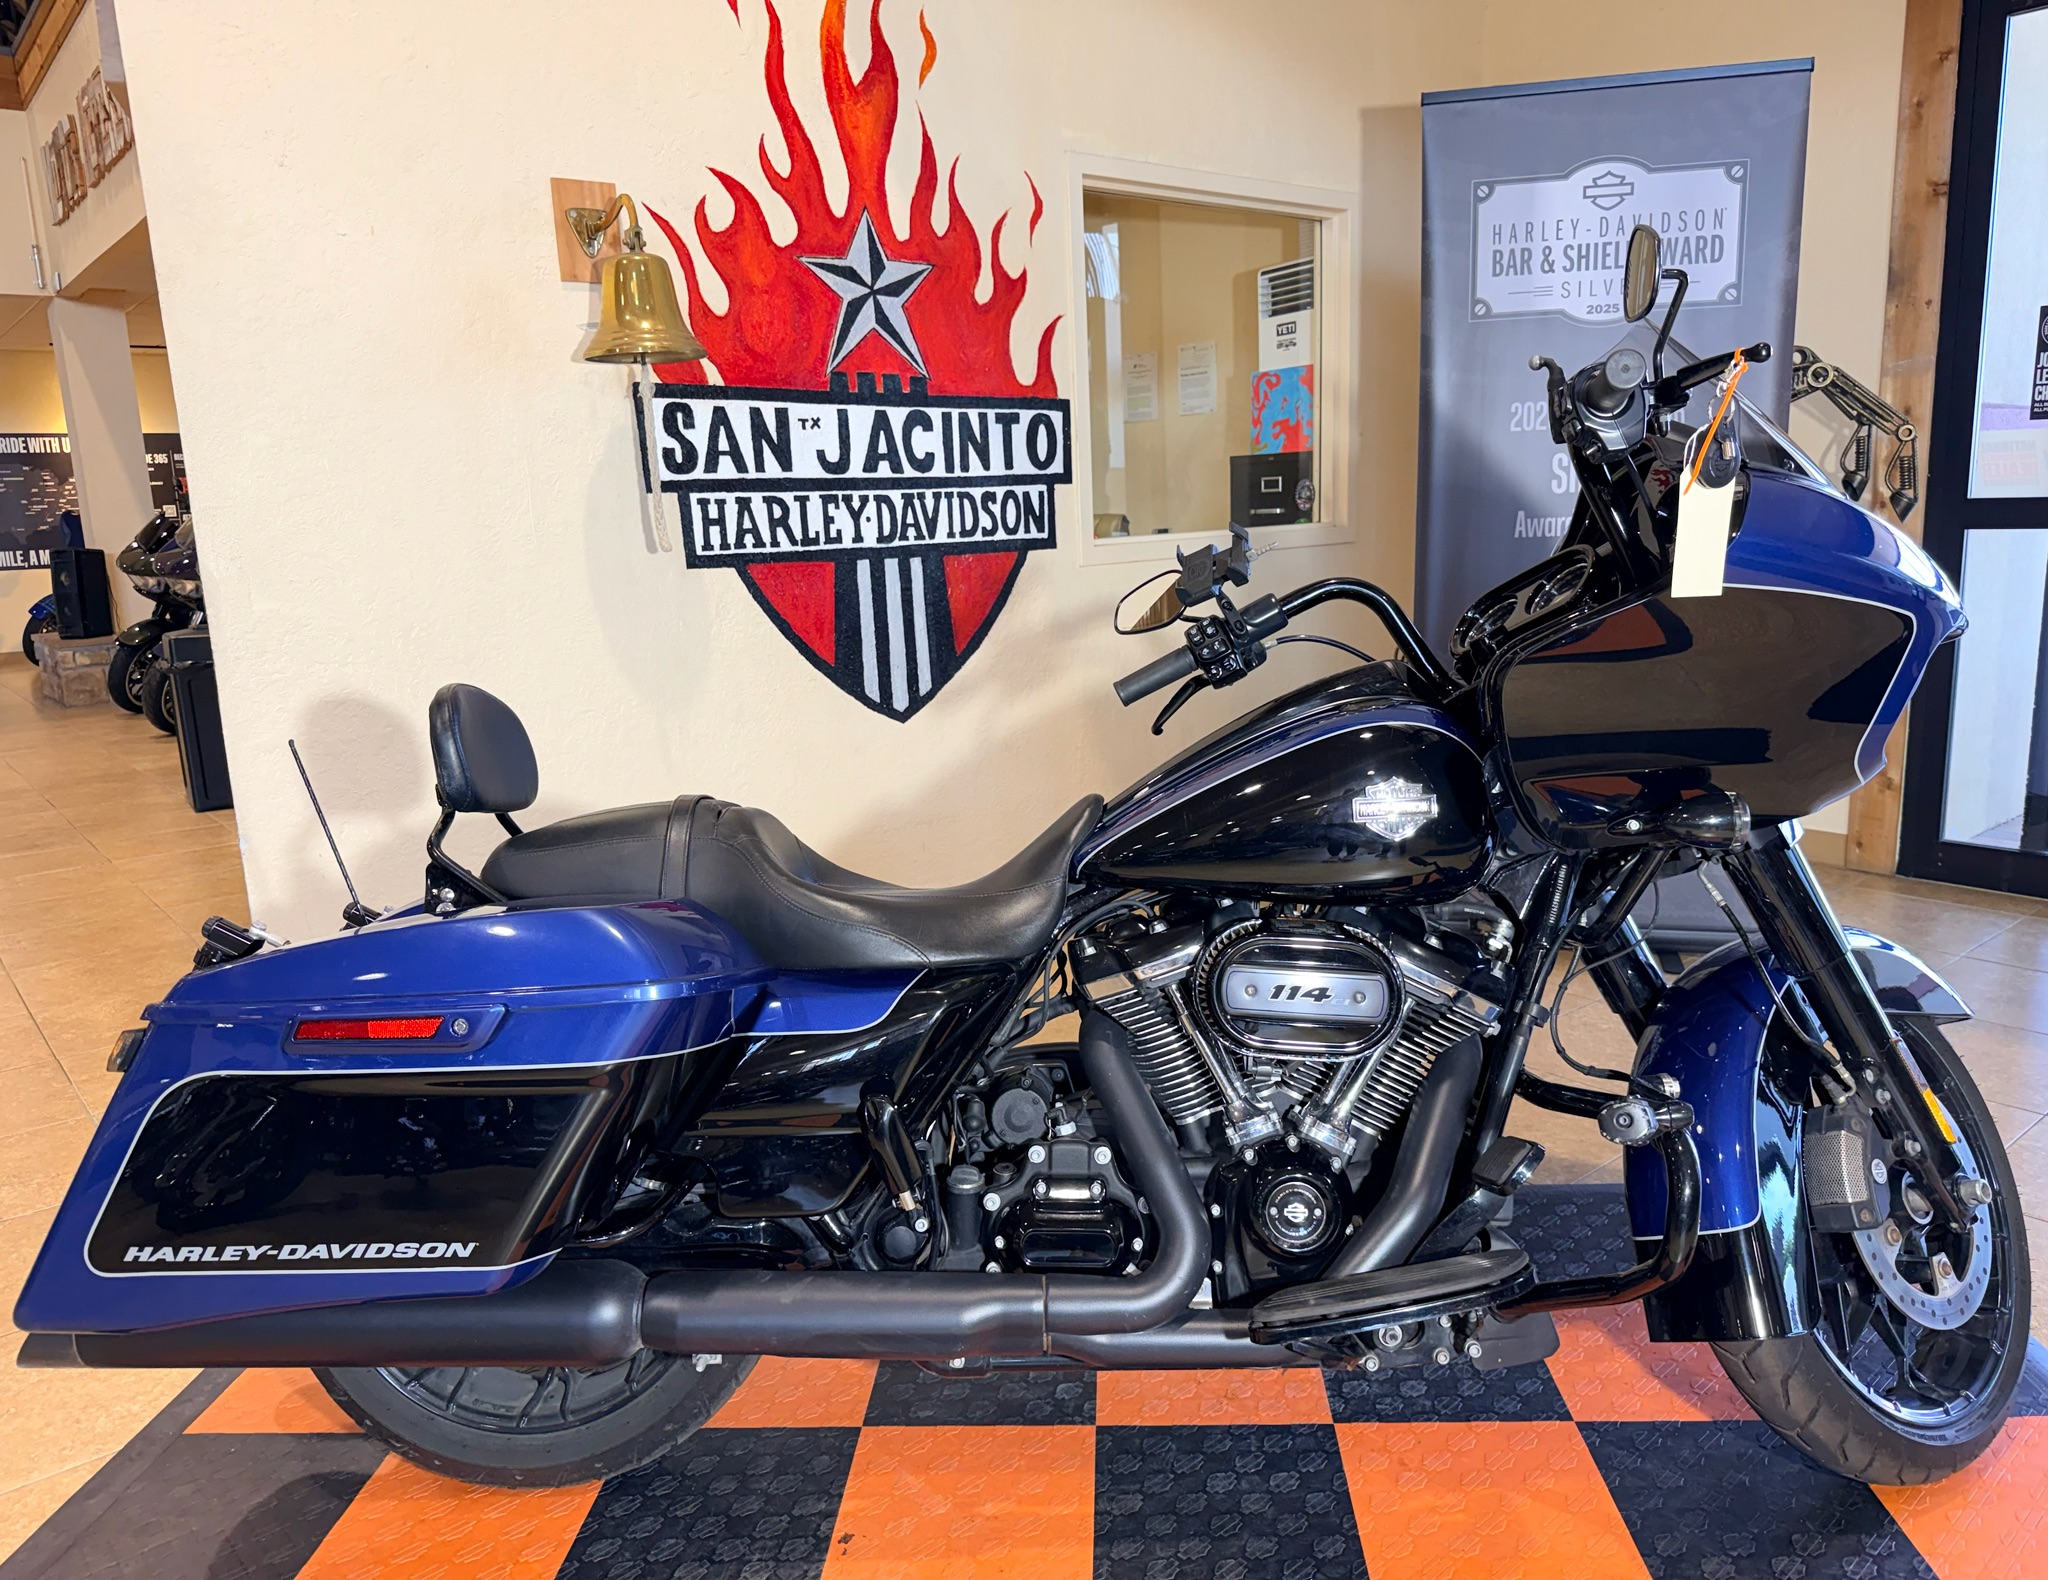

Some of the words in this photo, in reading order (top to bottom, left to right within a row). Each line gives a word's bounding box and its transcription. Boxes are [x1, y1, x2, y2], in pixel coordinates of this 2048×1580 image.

[1491, 247, 1533, 278] BAR
[1539, 245, 1556, 274] &
[1561, 240, 1629, 272] SHIEL
[1659, 234, 1725, 266] WARD
[1560, 278, 1624, 299] SILV
[1586, 303, 1620, 315] 2025
[1277, 323, 1296, 335] YETI
[1510, 400, 1549, 431] 202
[0, 437, 27, 453] RIDE
[26, 437, 60, 453] WITH
[61, 436, 71, 453] U
[661, 401, 794, 475] SAN
[798, 417, 822, 431] TX
[816, 408, 1058, 475] JACINTO
[153, 453, 168, 464] 365
[29, 550, 39, 566] A
[1267, 984, 1335, 1004] 114
[123, 1241, 477, 1262] HARLEY-DAVIDSON
